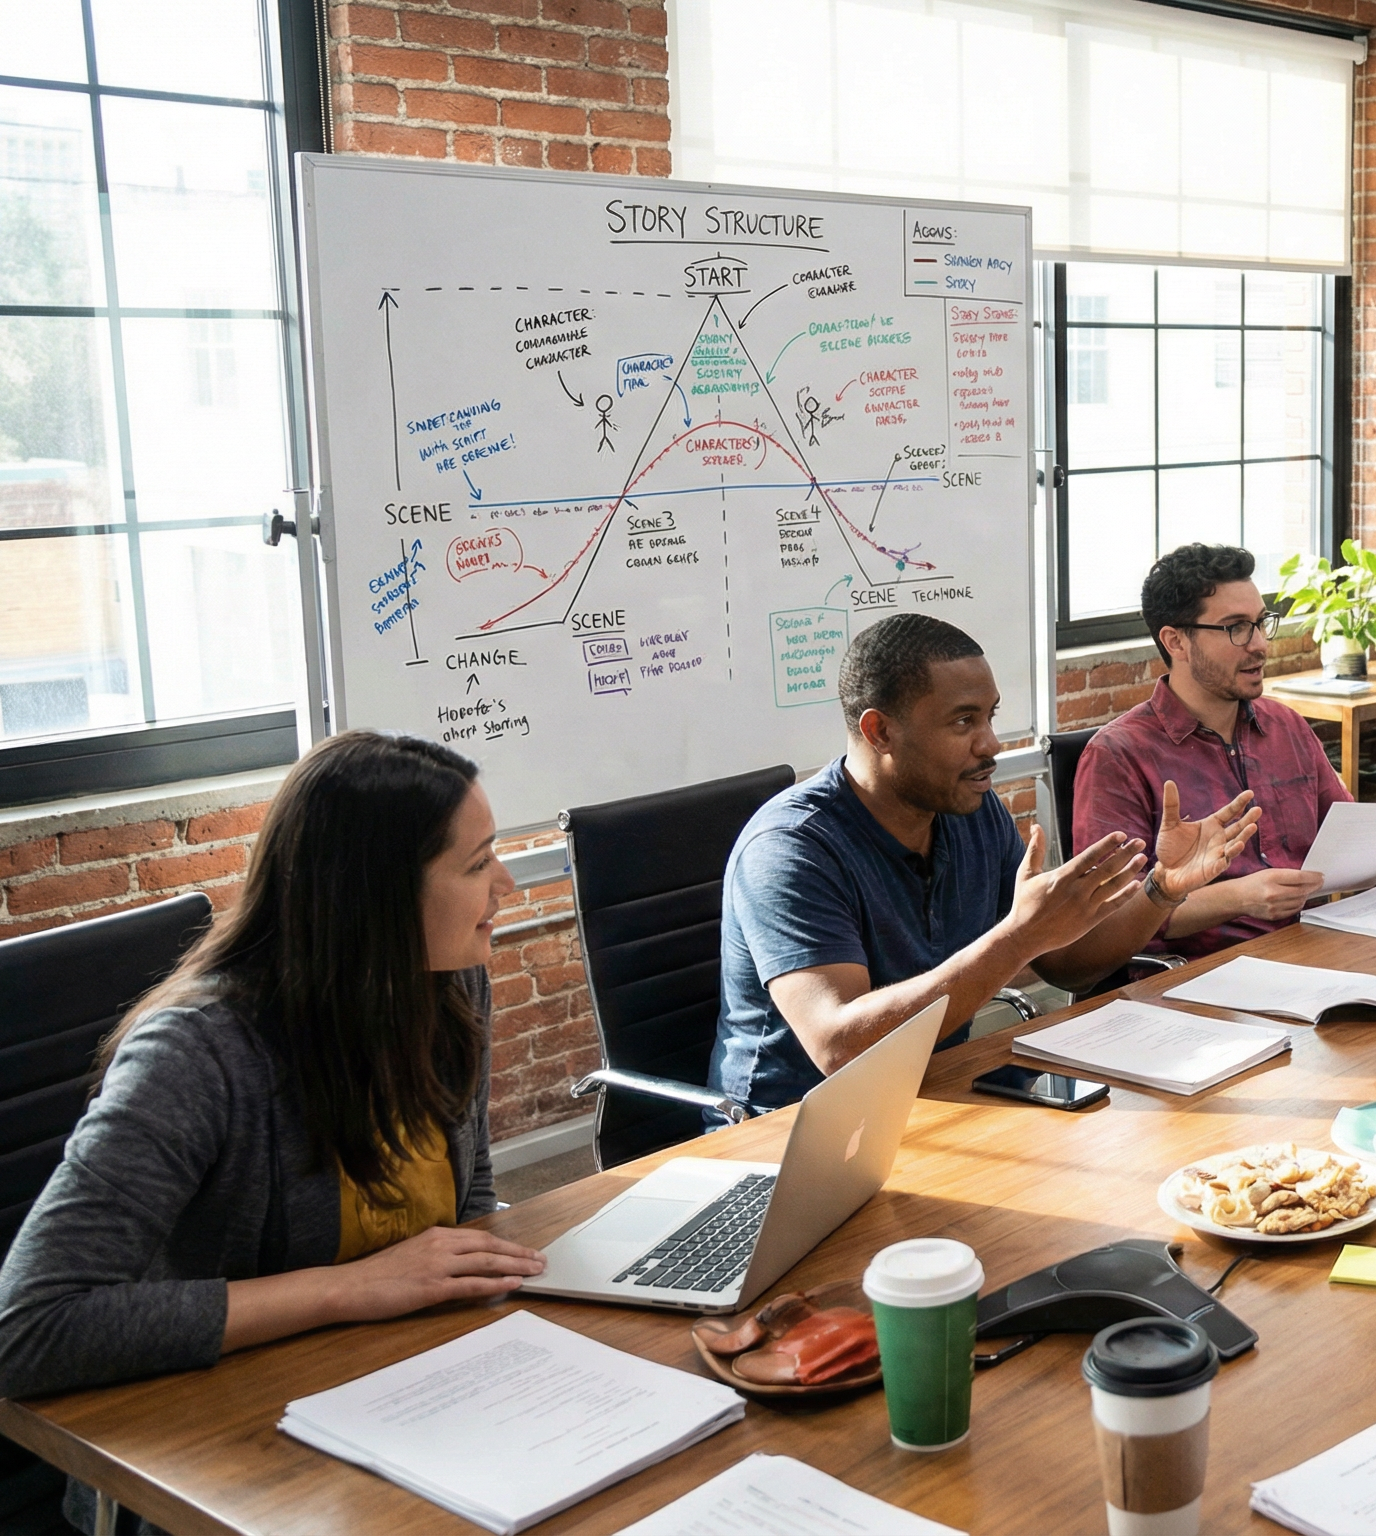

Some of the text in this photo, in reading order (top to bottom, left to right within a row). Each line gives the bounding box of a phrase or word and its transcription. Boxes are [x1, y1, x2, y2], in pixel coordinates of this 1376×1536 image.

[606, 200, 824, 239] STORY STRUCTURE
[684, 266, 748, 288] START
[943, 471, 982, 488] SCENE
[384, 503, 453, 525] SCENE
[662, 511, 675, 527] 3
[811, 504, 822, 520] 4
[850, 587, 896, 606] SCENE
[571, 610, 626, 631] SCENE
[446, 649, 527, 670] CHANGE
